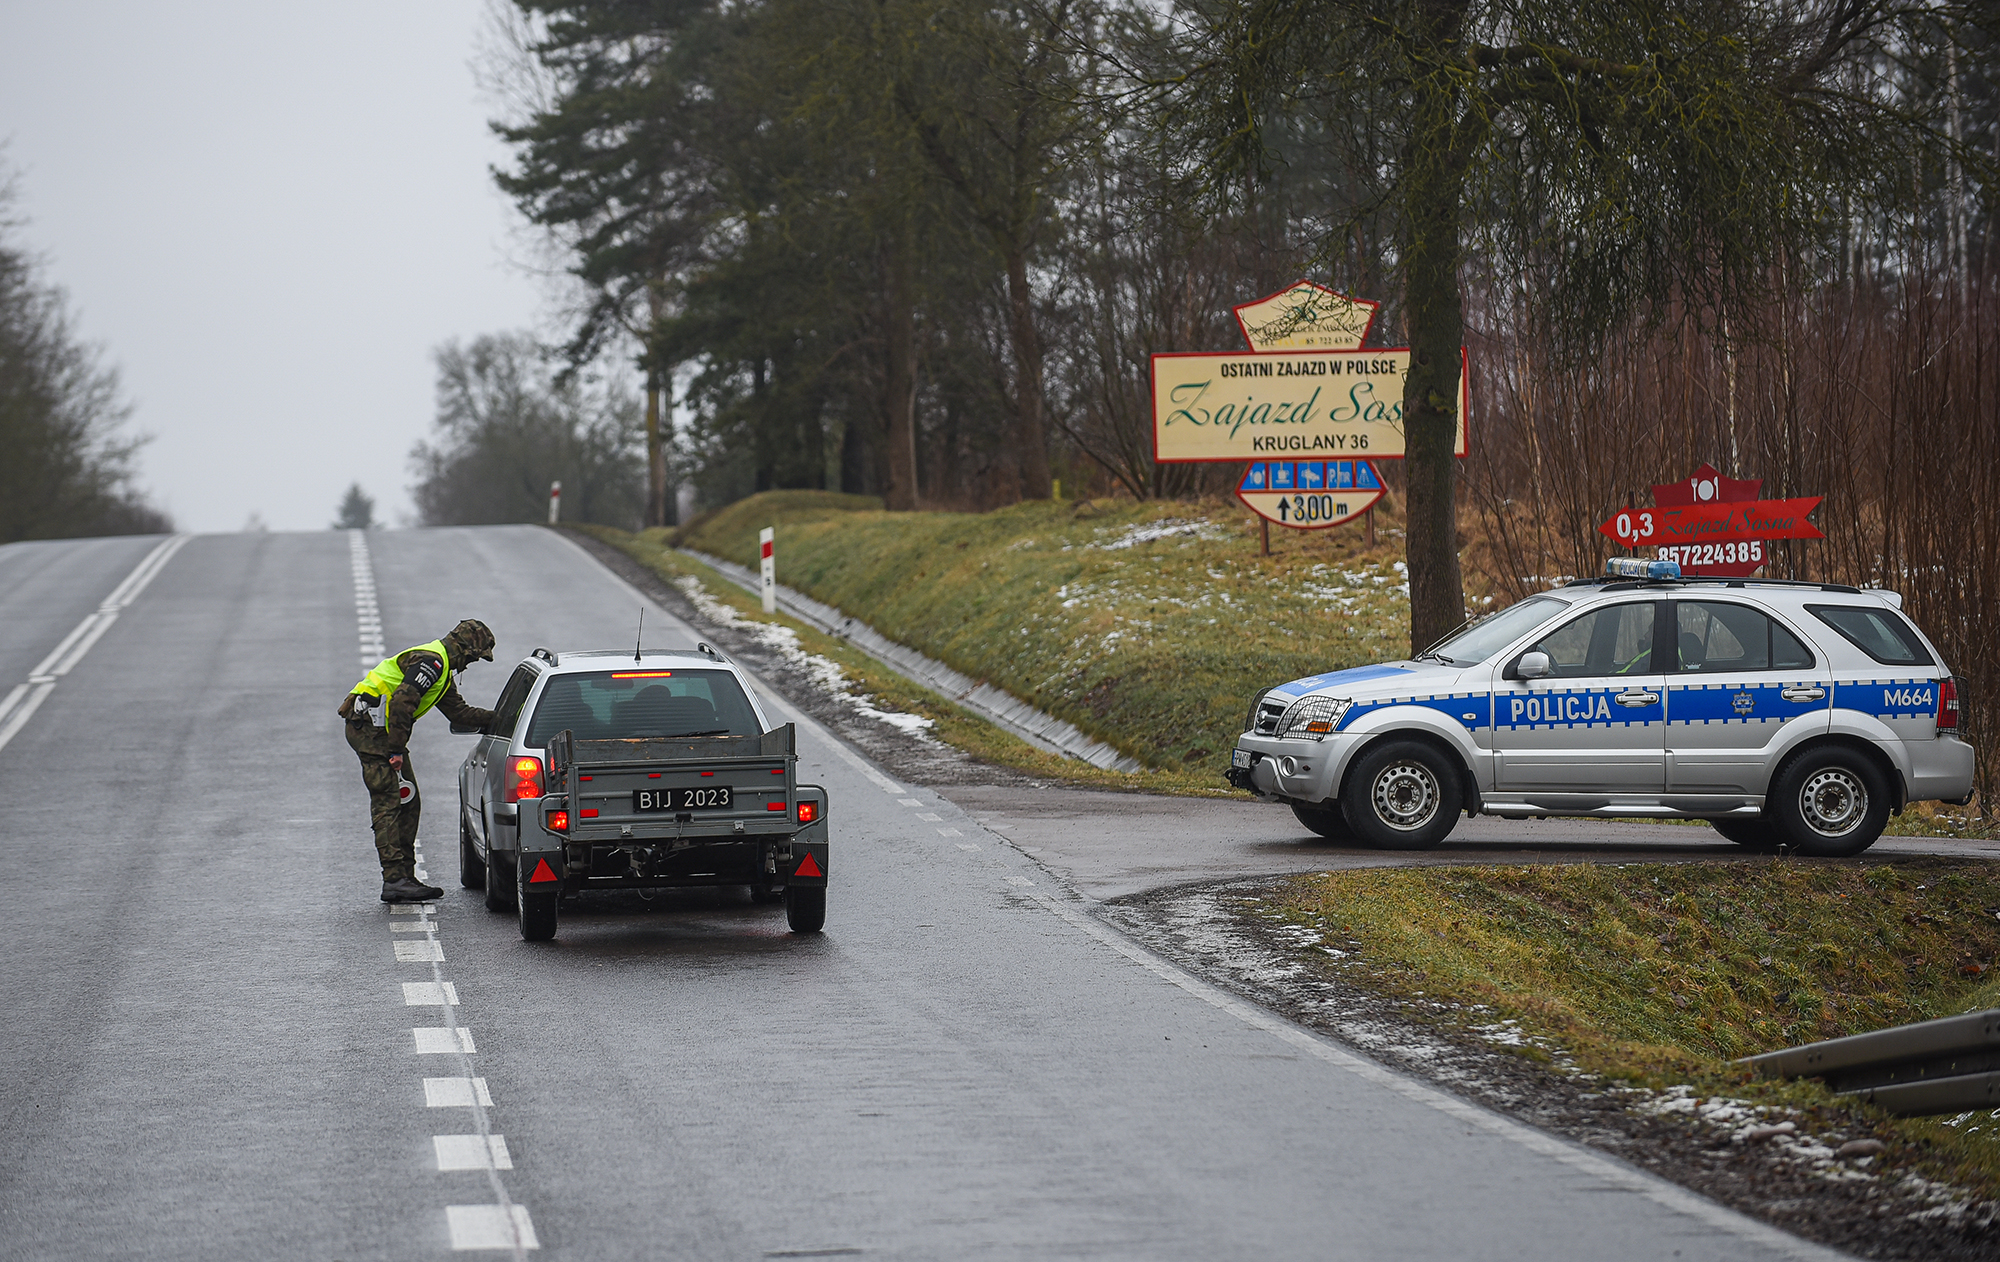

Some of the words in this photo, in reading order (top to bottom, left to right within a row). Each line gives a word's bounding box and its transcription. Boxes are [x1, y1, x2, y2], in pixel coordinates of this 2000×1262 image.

[1221, 362, 1273, 378] OSTATNI
[1277, 361, 1326, 377] ZAJAZD
[1330, 360, 1342, 375] W
[1347, 359, 1397, 375] POLSCE
[1165, 379, 1321, 440] Zajazd
[1329, 381, 1403, 425] Sos
[1253, 434, 1346, 451] KRUGLANY
[1350, 434, 1369, 450] 36
[1616, 512, 1654, 543] 0,3
[1661, 509, 1735, 541] Zajazd
[1735, 507, 1795, 532] Sosna
[1658, 540, 1762, 566] 857224385
[415, 672, 432, 688] MP
[1883, 688, 1933, 707] M664
[1511, 695, 1612, 722] POLICJA
[640, 791, 671, 809] BIJ
[684, 788, 729, 807] 2023
